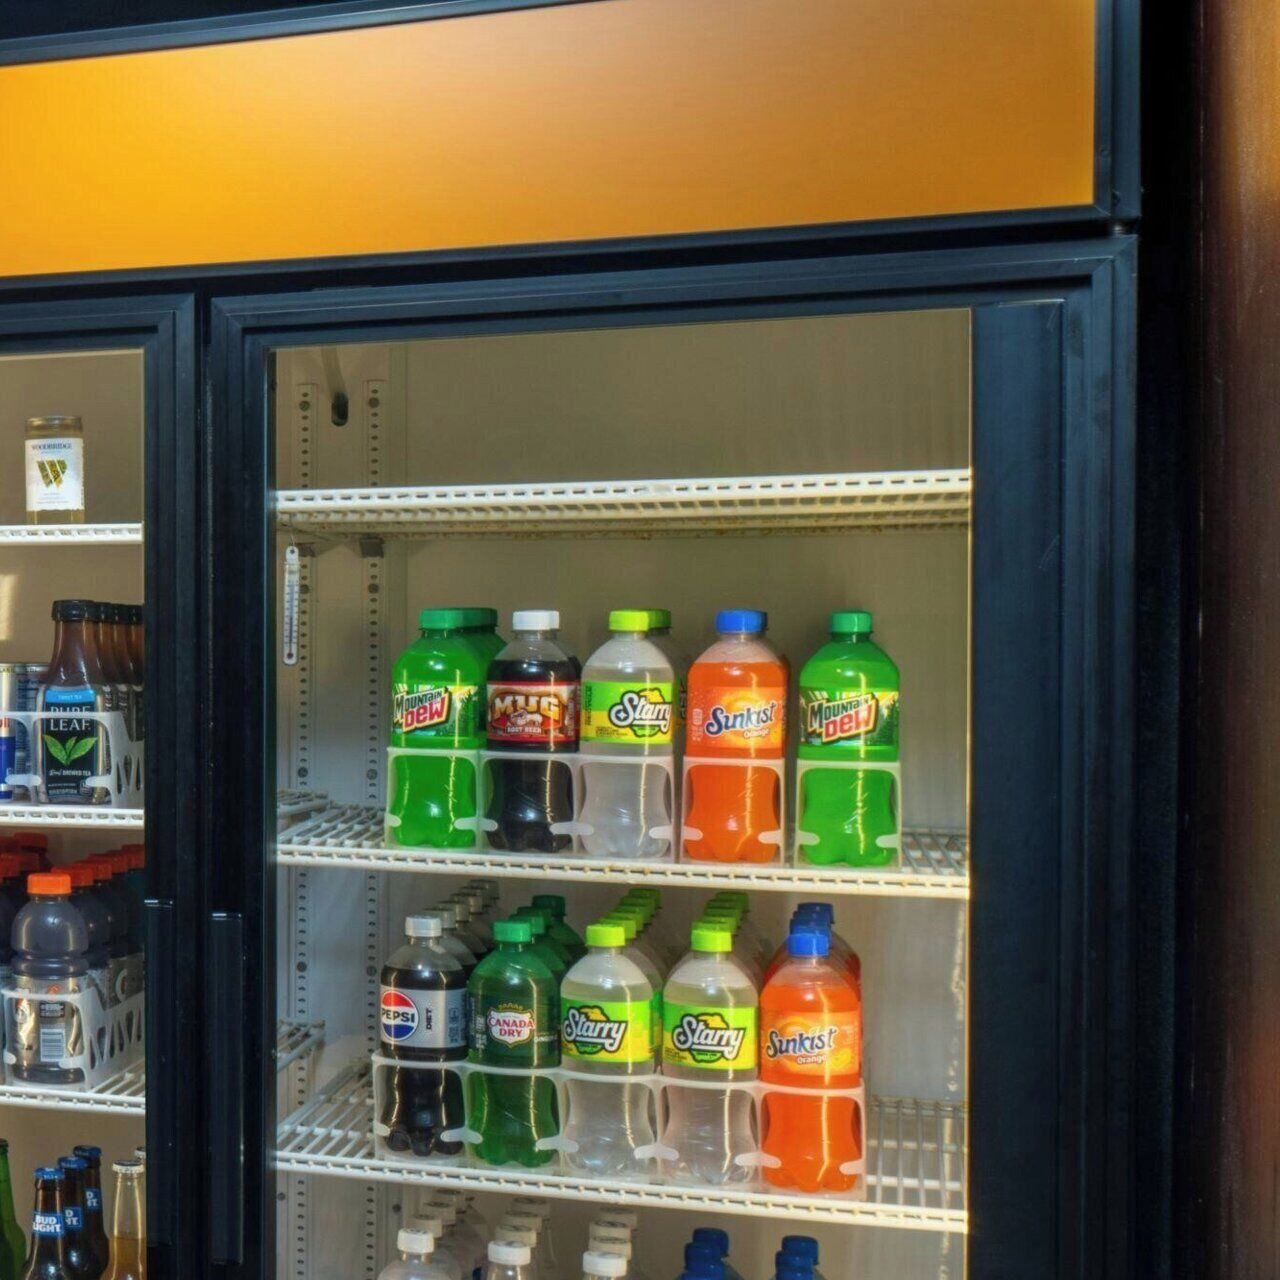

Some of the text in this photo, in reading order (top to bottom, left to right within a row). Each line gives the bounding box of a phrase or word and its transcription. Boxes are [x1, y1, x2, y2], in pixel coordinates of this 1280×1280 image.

[31, 442, 73, 451] WOODBRIDGE
[493, 695, 560, 720] MUG
[50, 718, 92, 732] LEAF
[705, 702, 777, 737] Sunkist
[381, 1007, 416, 1024] PEPSI
[425, 1007, 433, 1031] DIET
[488, 1016, 535, 1029] CANADA
[498, 1028, 523, 1038] DRY
[562, 1008, 627, 1052] Starry
[672, 1015, 746, 1060] Starry
[765, 1025, 838, 1058] Sunkist
[32, 1223, 62, 1234] LIGHT
[35, 1214, 58, 1226] BUD
